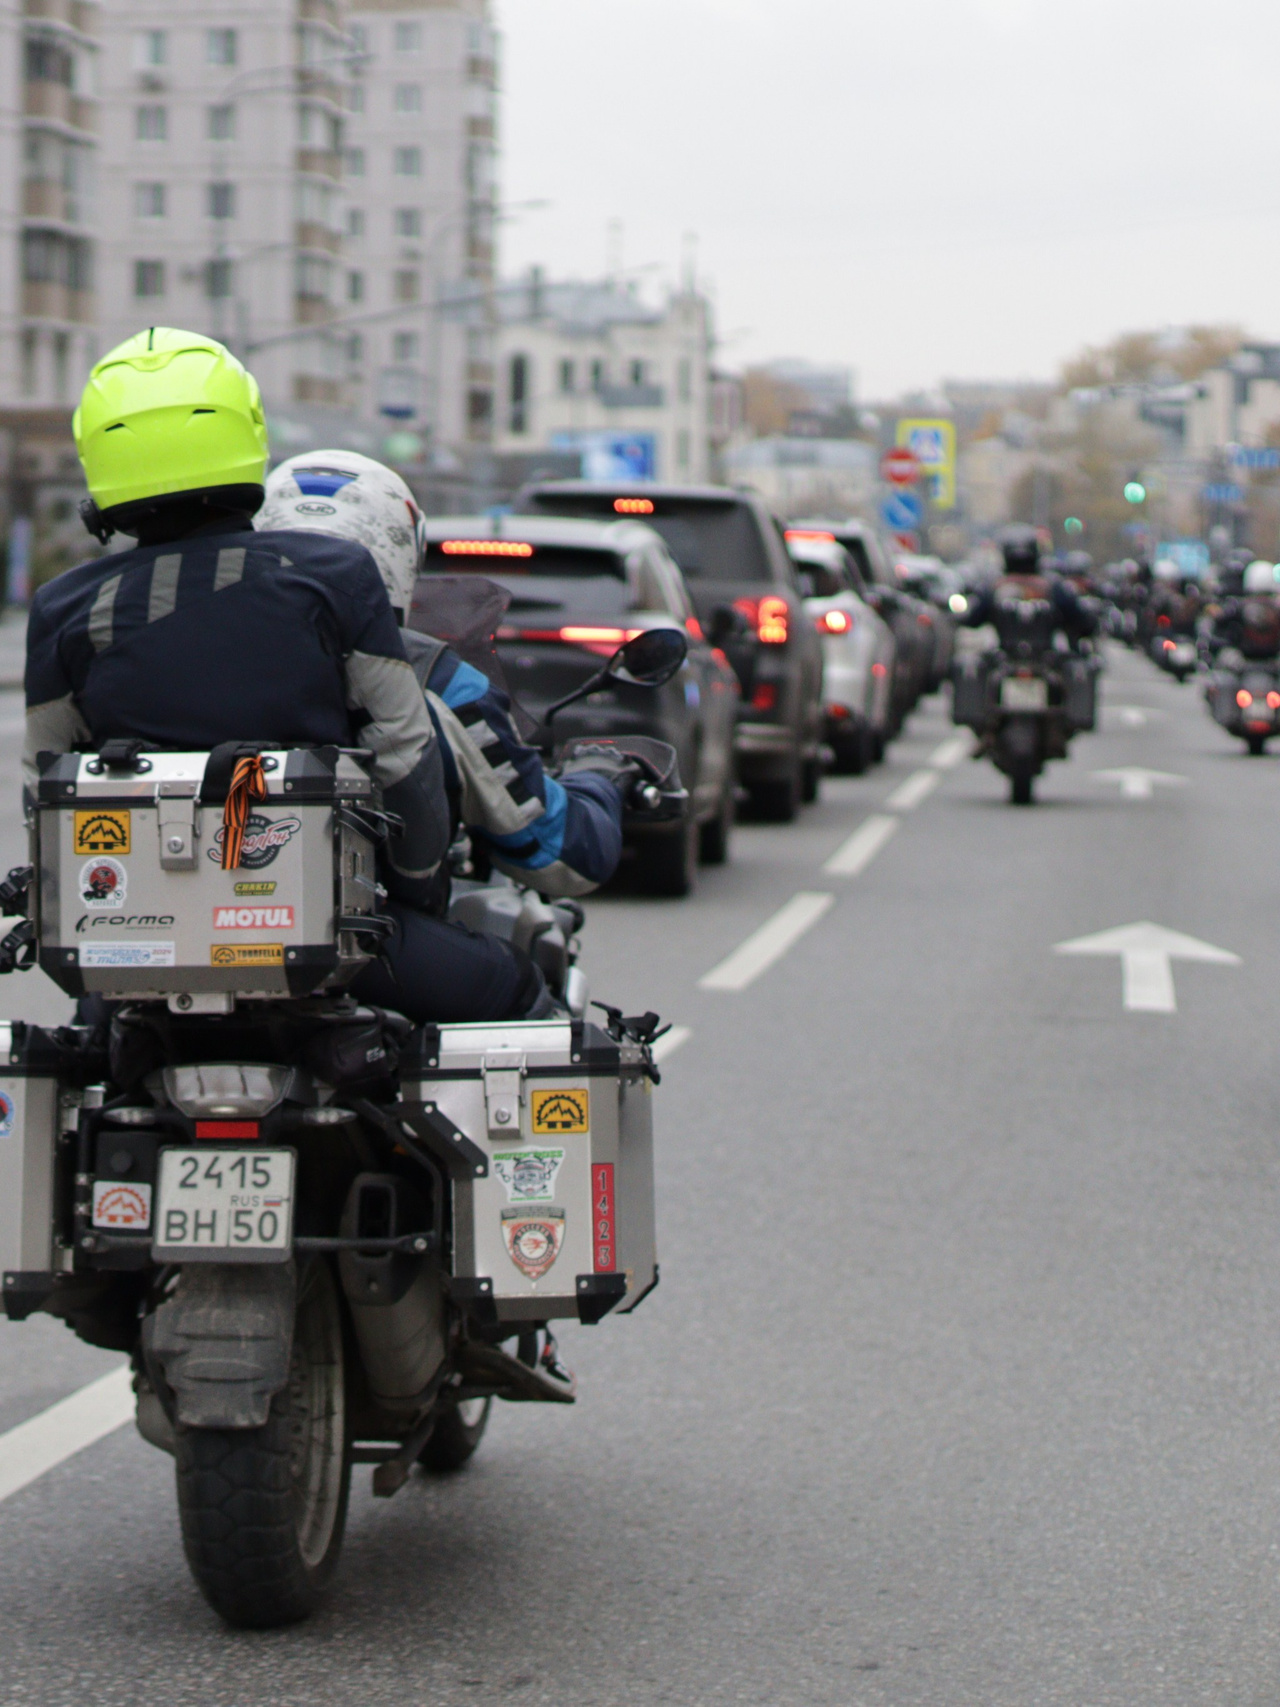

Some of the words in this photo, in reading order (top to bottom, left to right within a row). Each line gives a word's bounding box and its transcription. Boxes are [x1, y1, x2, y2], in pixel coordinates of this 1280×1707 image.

[215, 908, 292, 927] MOTUL
[179, 1156, 271, 1189] 2415
[230, 1195, 261, 1207] RUS
[233, 1209, 279, 1243] 50
